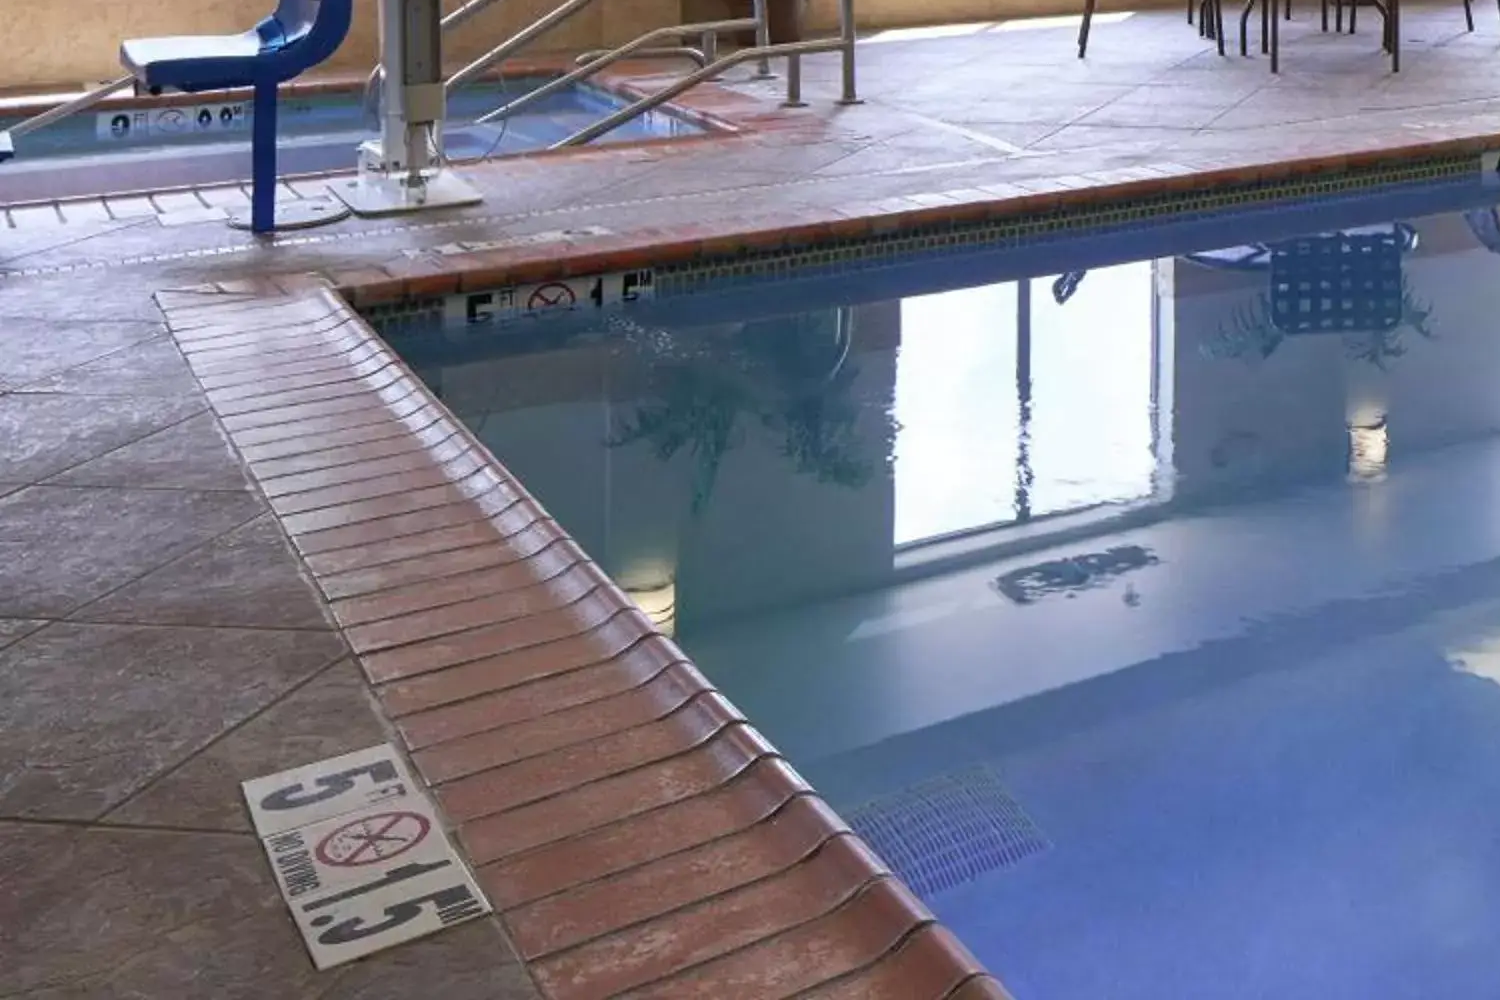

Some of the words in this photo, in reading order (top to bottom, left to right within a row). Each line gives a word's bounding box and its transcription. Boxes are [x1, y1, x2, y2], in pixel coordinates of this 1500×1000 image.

[260, 759, 399, 811] 5
[268, 832, 305, 852] NO
[276, 850, 321, 897] DIVING
[302, 859, 474, 945] 1.5
[438, 898, 484, 924] M
